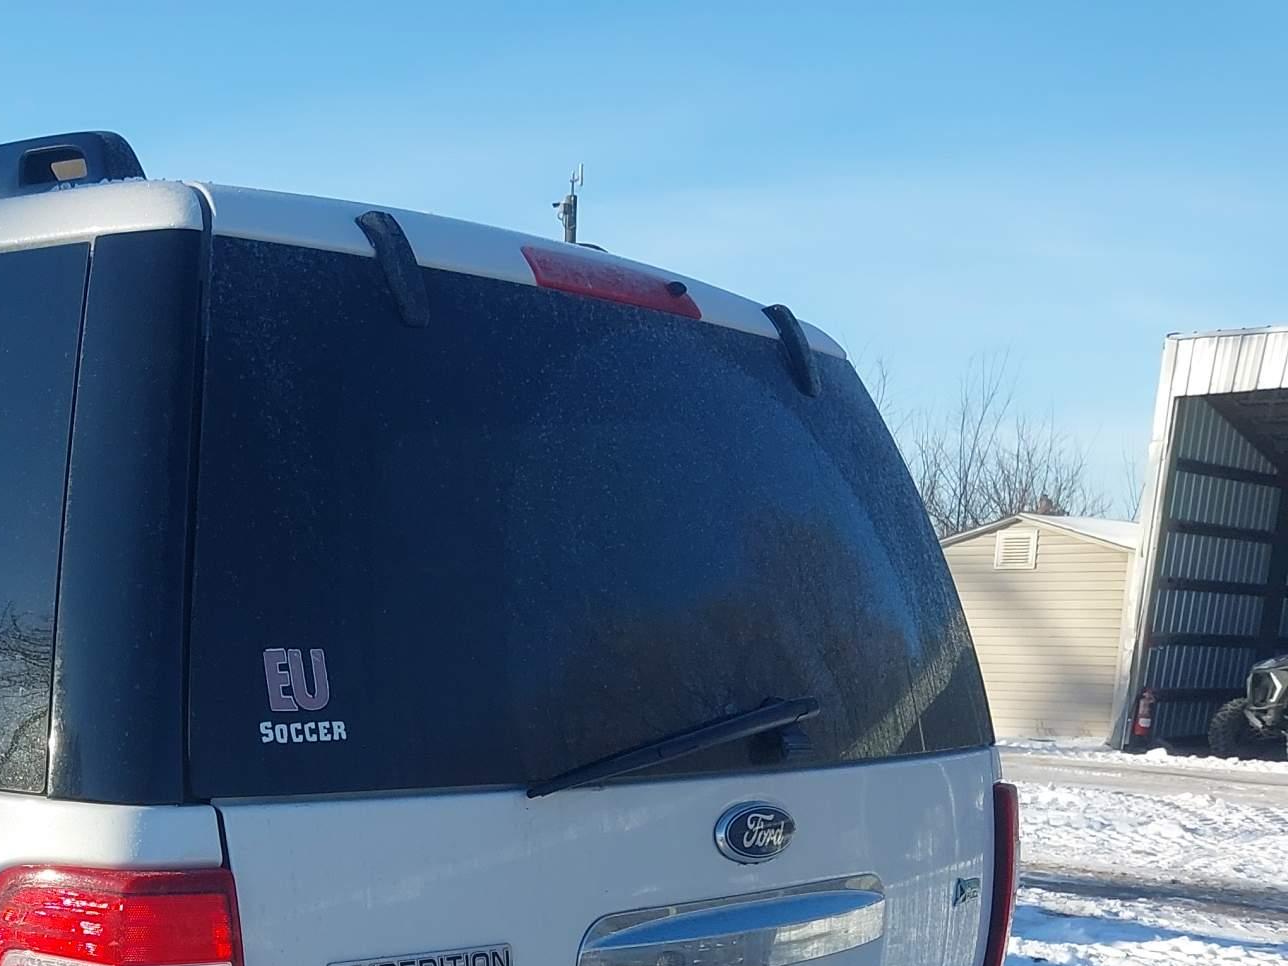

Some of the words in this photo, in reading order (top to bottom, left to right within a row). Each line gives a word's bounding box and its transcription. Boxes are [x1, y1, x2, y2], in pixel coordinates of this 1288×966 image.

[263, 648, 330, 712] EU
[259, 721, 347, 743] SOCCER
[743, 813, 785, 848] Ford
